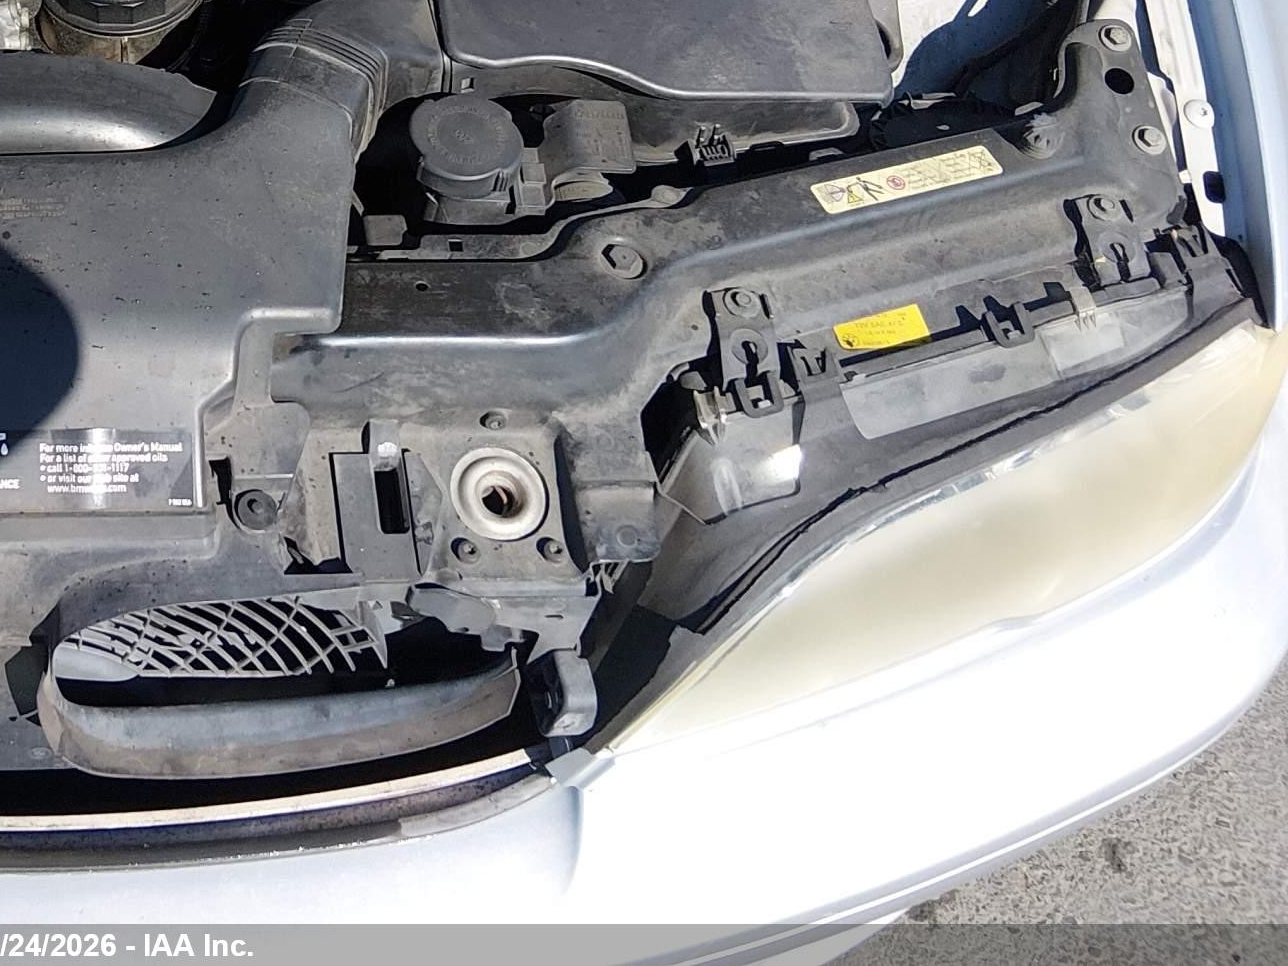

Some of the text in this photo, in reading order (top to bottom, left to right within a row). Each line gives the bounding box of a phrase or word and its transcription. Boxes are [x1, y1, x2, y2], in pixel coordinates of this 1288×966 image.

[40, 443, 55, 453] For
[56, 444, 78, 453] more
[114, 442, 149, 452] Owner's
[150, 441, 183, 452] Manual
[40, 453, 55, 463] For
[63, 453, 76, 463] list
[78, 453, 87, 463] of
[152, 453, 168, 463] oils
[47, 463, 63, 473] call
[47, 475, 56, 483] or
[58, 473, 76, 483] visit
[113, 473, 129, 483] site
[130, 473, 139, 483] at
